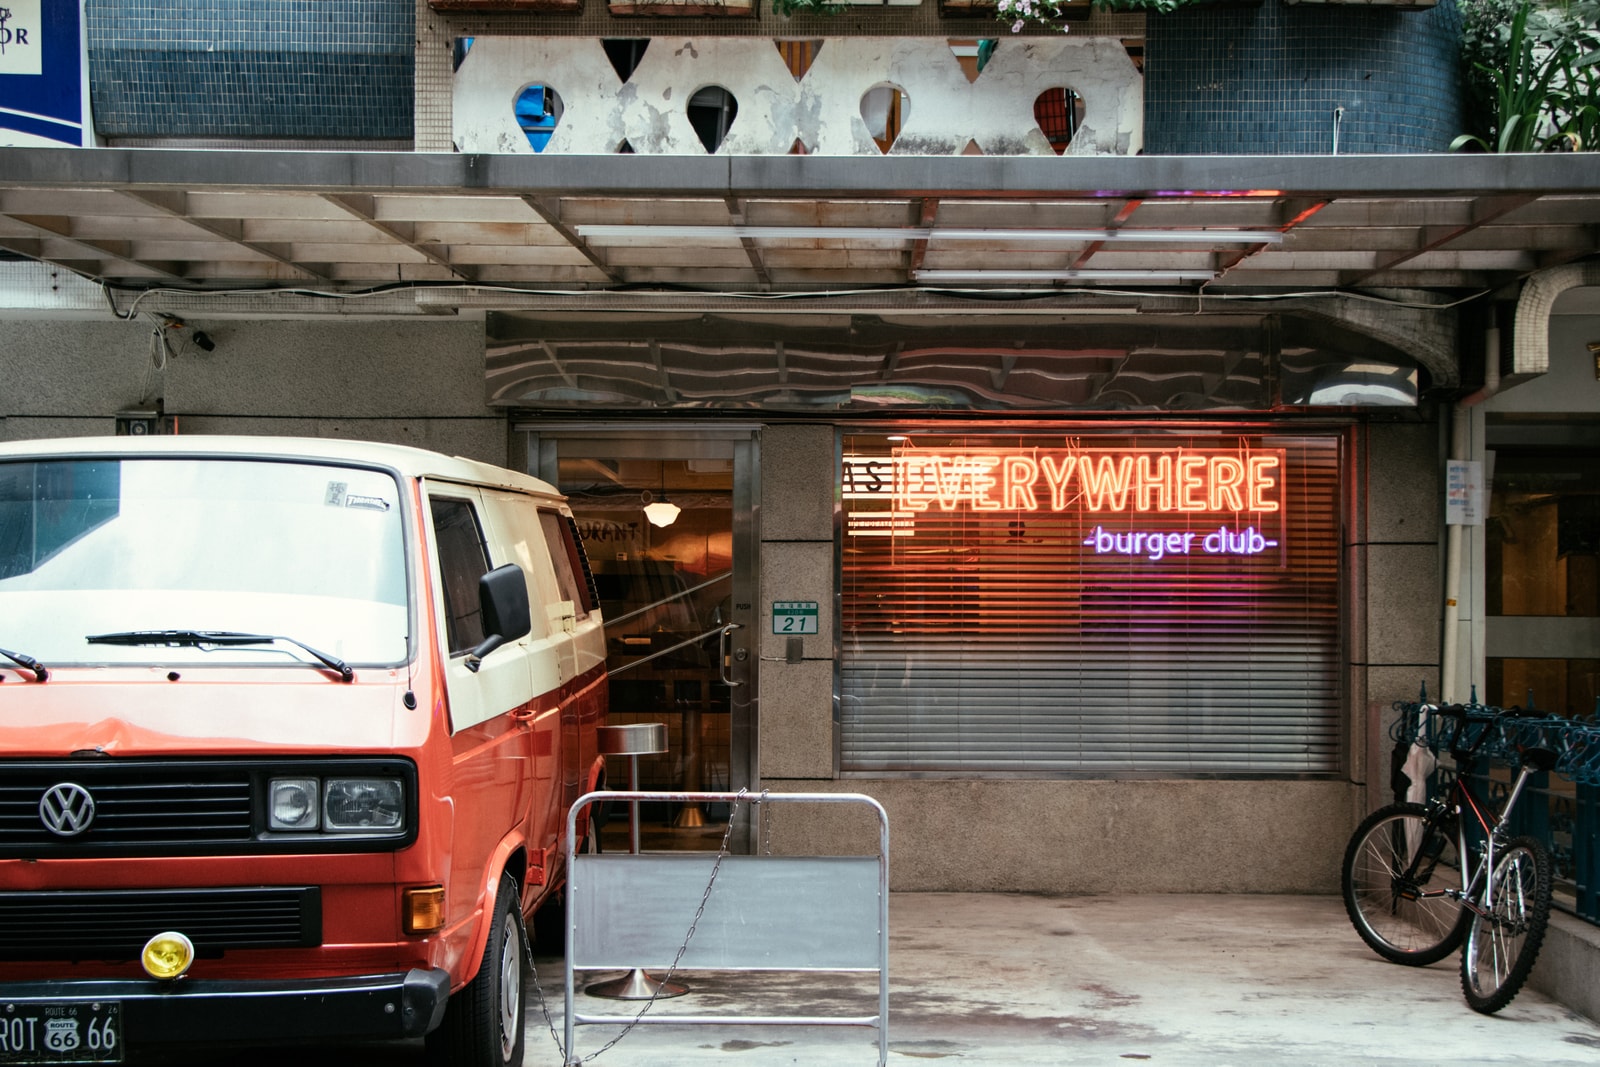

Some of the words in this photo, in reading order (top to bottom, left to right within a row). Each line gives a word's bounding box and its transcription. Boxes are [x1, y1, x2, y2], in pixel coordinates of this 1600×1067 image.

[898, 454, 1280, 512] EVERYWHERE
[782, 617, 806, 631] 21
[45, 1007, 65, 1016] ROUTE
[68, 1007, 78, 1016] 66
[50, 1032, 76, 1048] 66
[88, 1016, 115, 1049] 66
